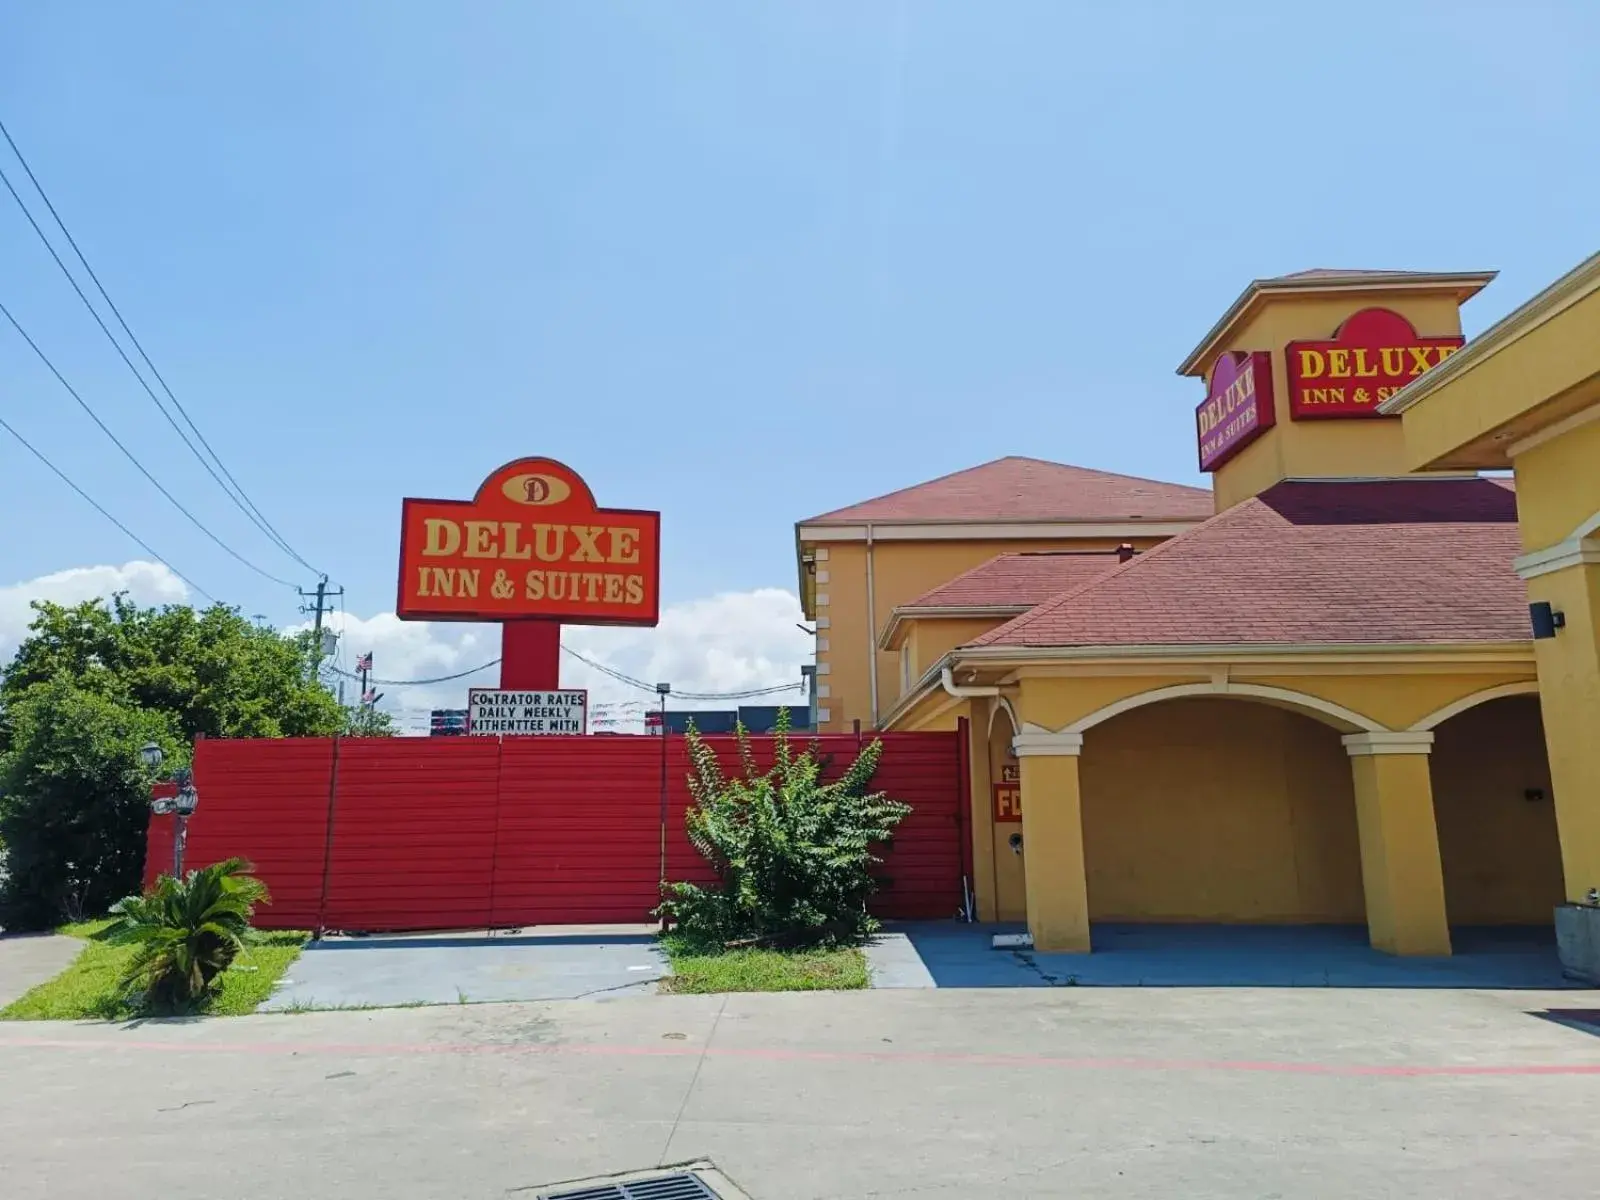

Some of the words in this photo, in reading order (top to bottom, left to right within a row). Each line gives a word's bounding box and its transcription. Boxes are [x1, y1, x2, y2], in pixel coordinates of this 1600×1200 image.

[1199, 366, 1255, 437] DELUXE
[1302, 388, 1345, 404] INN
[1353, 387, 1371, 403] &
[1225, 403, 1257, 441] SUITES
[523, 477, 550, 502] D
[422, 518, 640, 564] DELUXE
[417, 566, 480, 597] INN
[490, 568, 515, 599] &
[525, 569, 644, 604] SUITES
[547, 694, 584, 705] RATES
[471, 719, 544, 731] KITHENTTEE
[550, 720, 579, 731] WITH
[479, 707, 516, 718] DAILY
[524, 707, 572, 718] WEEKLY
